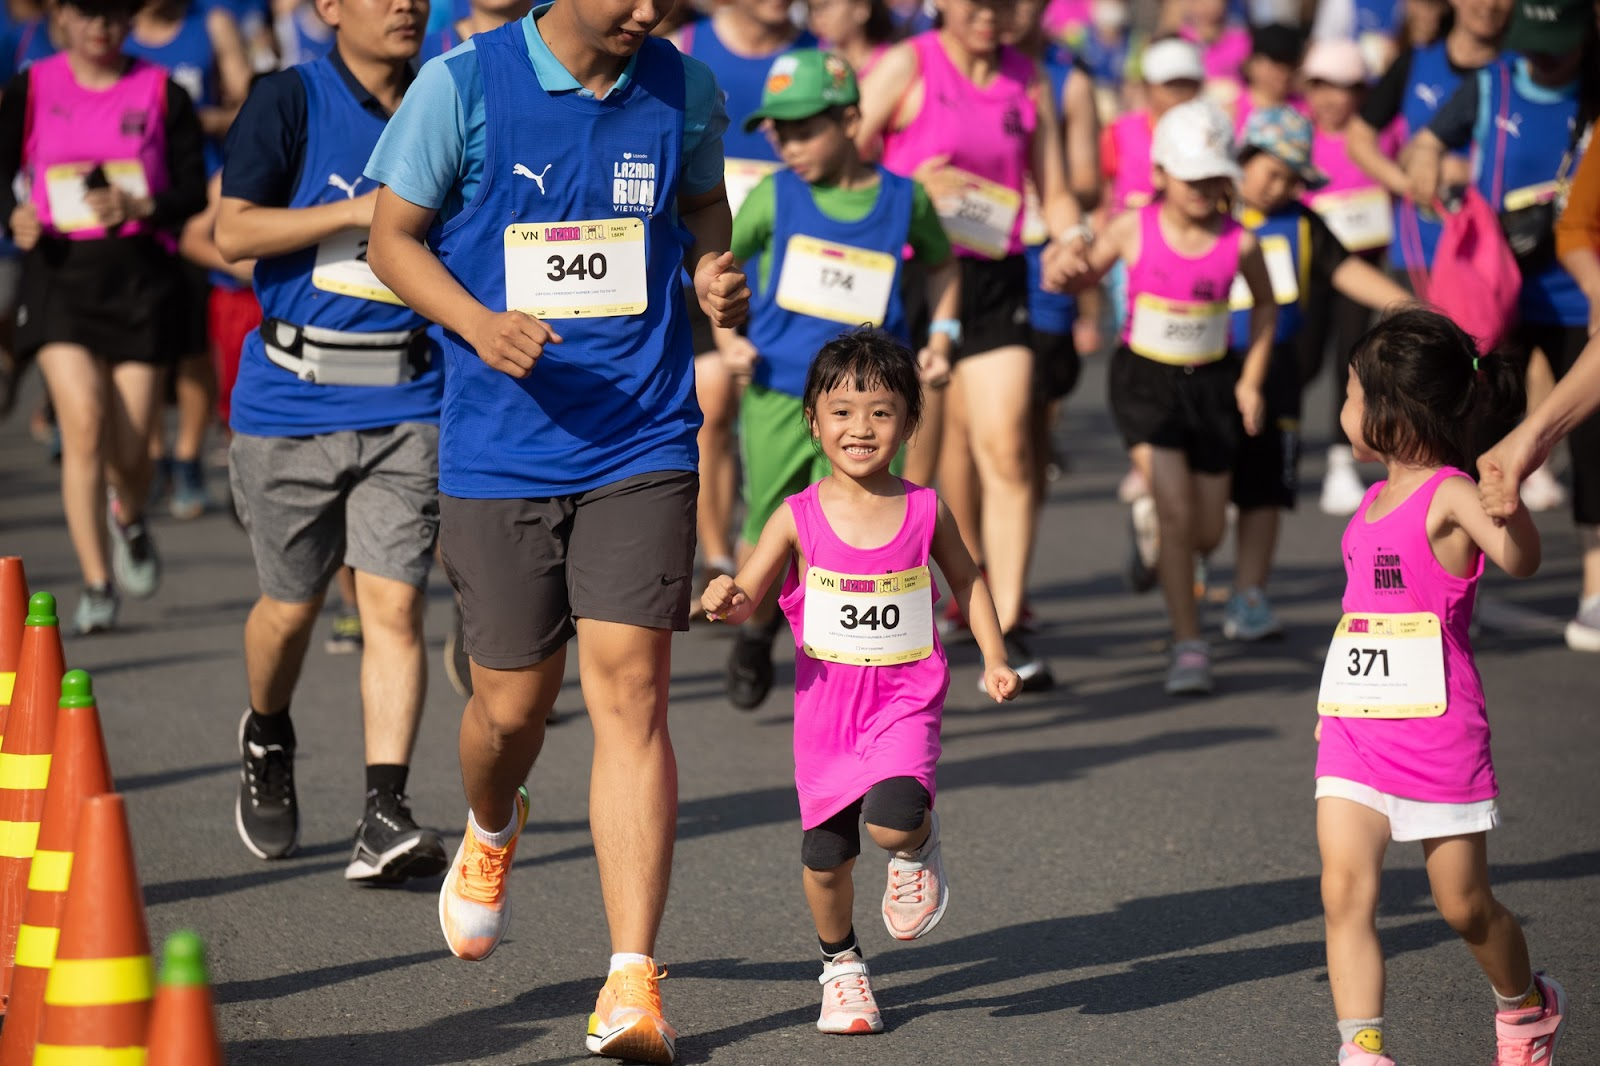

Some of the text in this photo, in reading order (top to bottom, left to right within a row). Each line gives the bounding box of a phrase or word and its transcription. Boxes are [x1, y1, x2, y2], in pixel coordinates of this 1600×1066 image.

[613, 161, 656, 179] LAZADA
[613, 178, 655, 207] RUN
[613, 205, 653, 213] VIETNAM
[521, 231, 538, 241] VN
[544, 226, 581, 242] LAZADA
[546, 252, 608, 282] 340
[1373, 554, 1401, 567] LAZADA
[820, 576, 835, 588] VN
[839, 577, 876, 593] LAZADA
[1374, 568, 1407, 589] RUN
[839, 603, 900, 631] 340
[1347, 647, 1390, 677] 371
